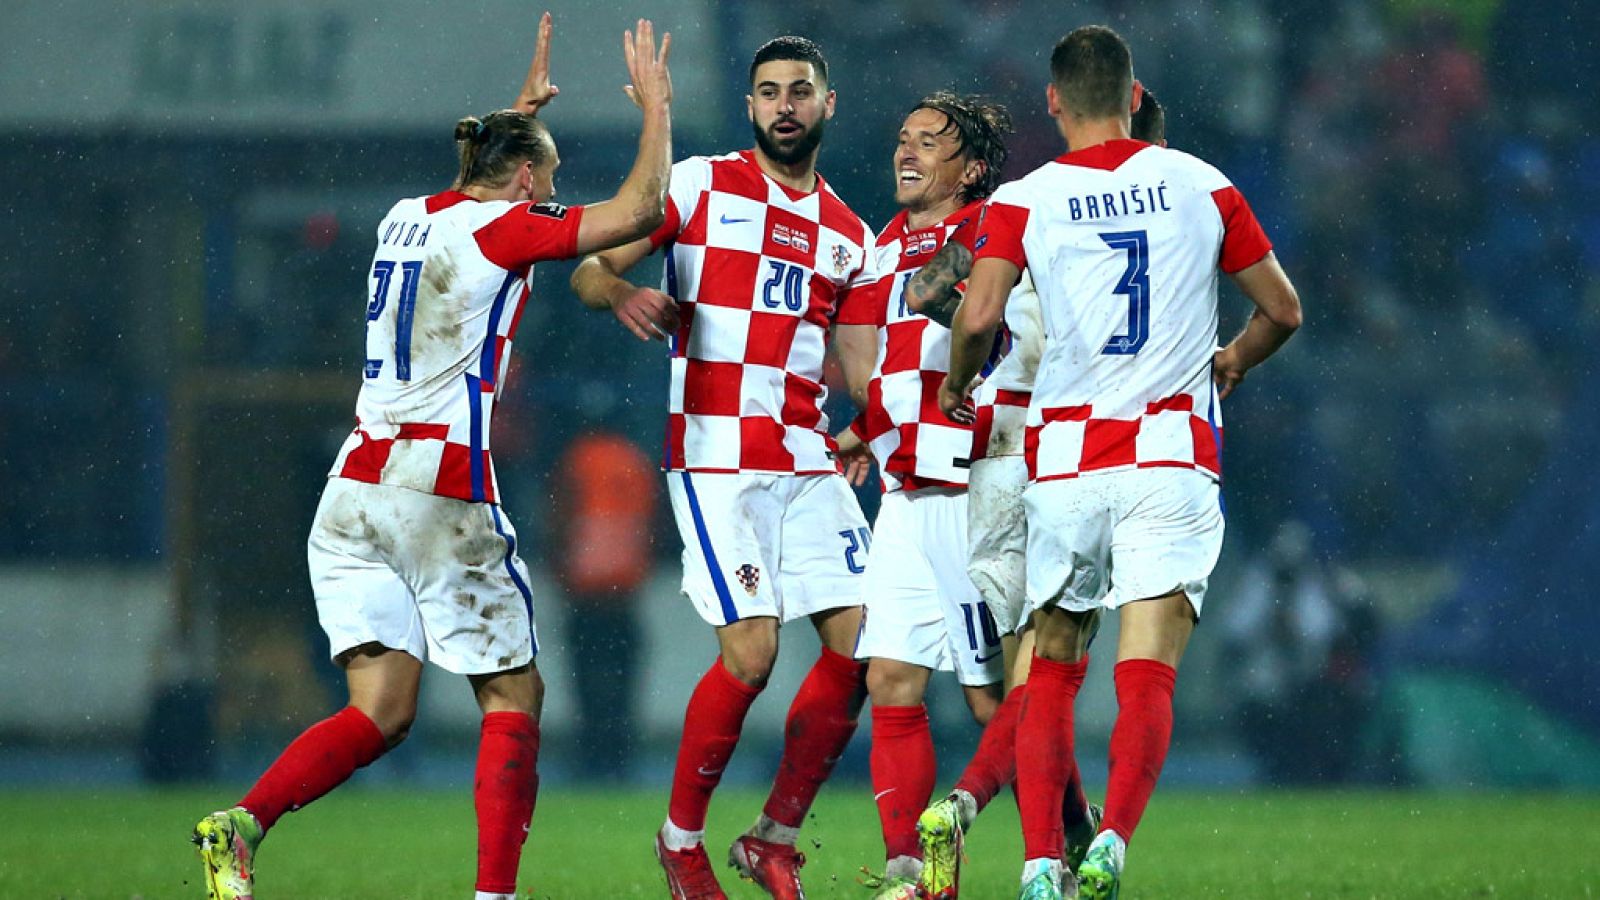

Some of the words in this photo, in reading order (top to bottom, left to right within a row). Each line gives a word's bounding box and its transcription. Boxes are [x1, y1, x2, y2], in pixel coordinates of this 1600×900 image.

[1068, 180, 1171, 221] BARIŠIĆ
[382, 221, 432, 248] VIDA
[763, 260, 804, 312] 20
[1097, 229, 1150, 355] 3
[366, 260, 423, 382] 21
